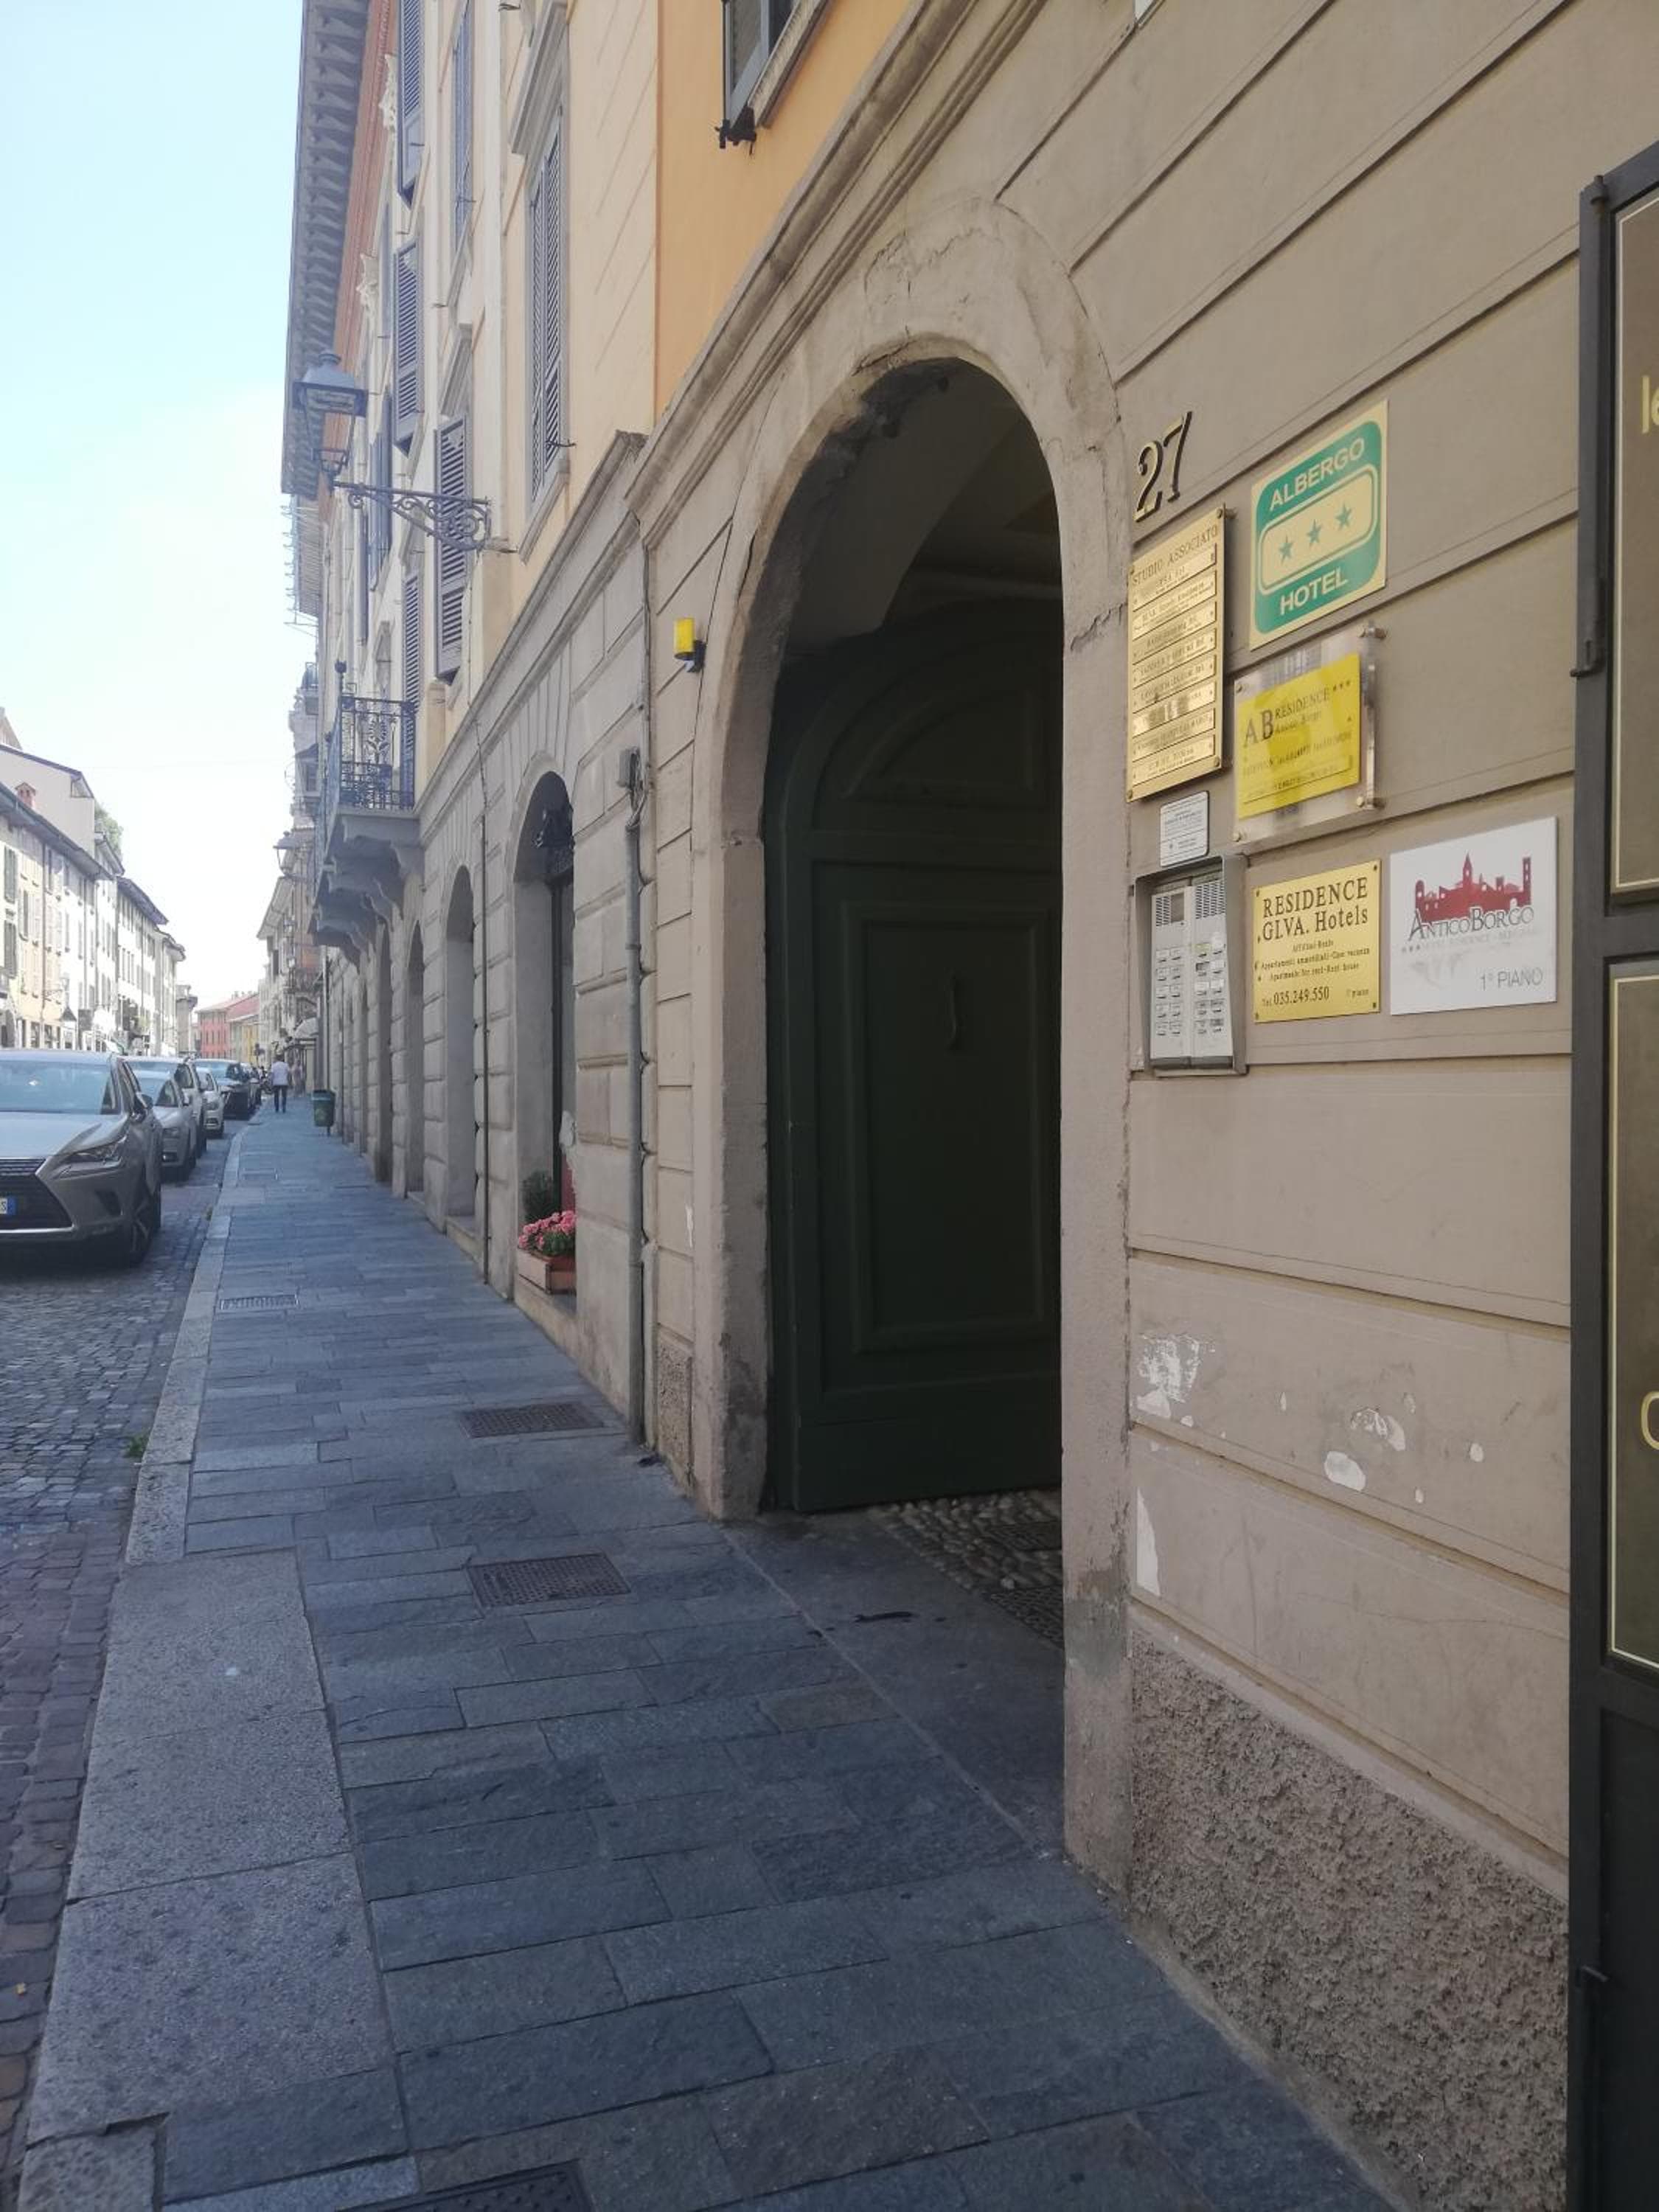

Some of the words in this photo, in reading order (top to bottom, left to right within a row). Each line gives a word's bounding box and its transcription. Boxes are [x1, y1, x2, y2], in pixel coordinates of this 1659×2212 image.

[1133, 411, 1192, 523] 27
[1269, 437, 1364, 511] ALBERGO
[1132, 558, 1163, 585] STUDIO
[1167, 524, 1217, 566] ASSOCIATO
[1280, 566, 1349, 615] HOTEL
[1275, 687, 1330, 719] RESIDENCE
[1263, 877, 1368, 918] RESIDENCE
[1315, 905, 1368, 933] Hotels
[1498, 967, 1544, 989] PIANO
